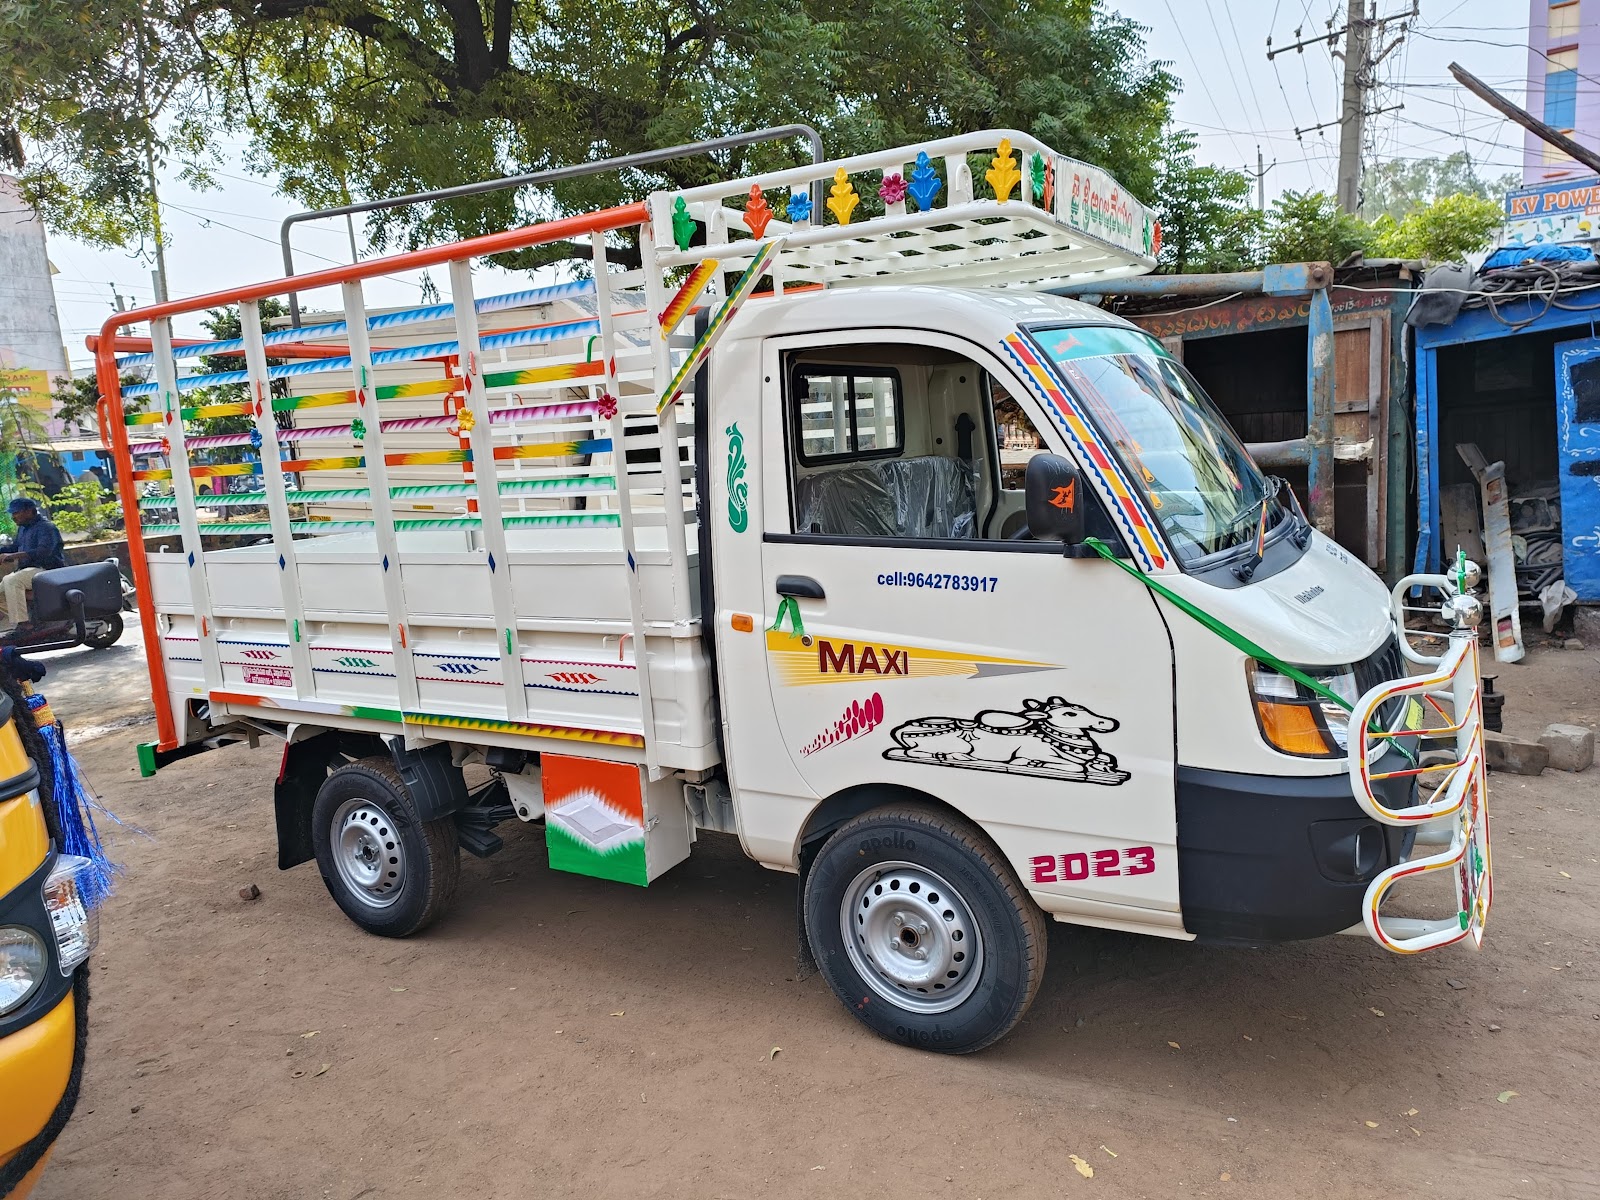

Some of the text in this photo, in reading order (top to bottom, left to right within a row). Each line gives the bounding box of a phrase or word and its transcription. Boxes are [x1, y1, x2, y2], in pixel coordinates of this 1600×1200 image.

[1510, 195, 1540, 216] KV
[877, 572, 998, 593] cell:9642783917
[818, 641, 909, 675] MAXI
[860, 830, 916, 854] apollo
[1028, 846, 1155, 883] 2023
[896, 1024, 954, 1042] apollo
